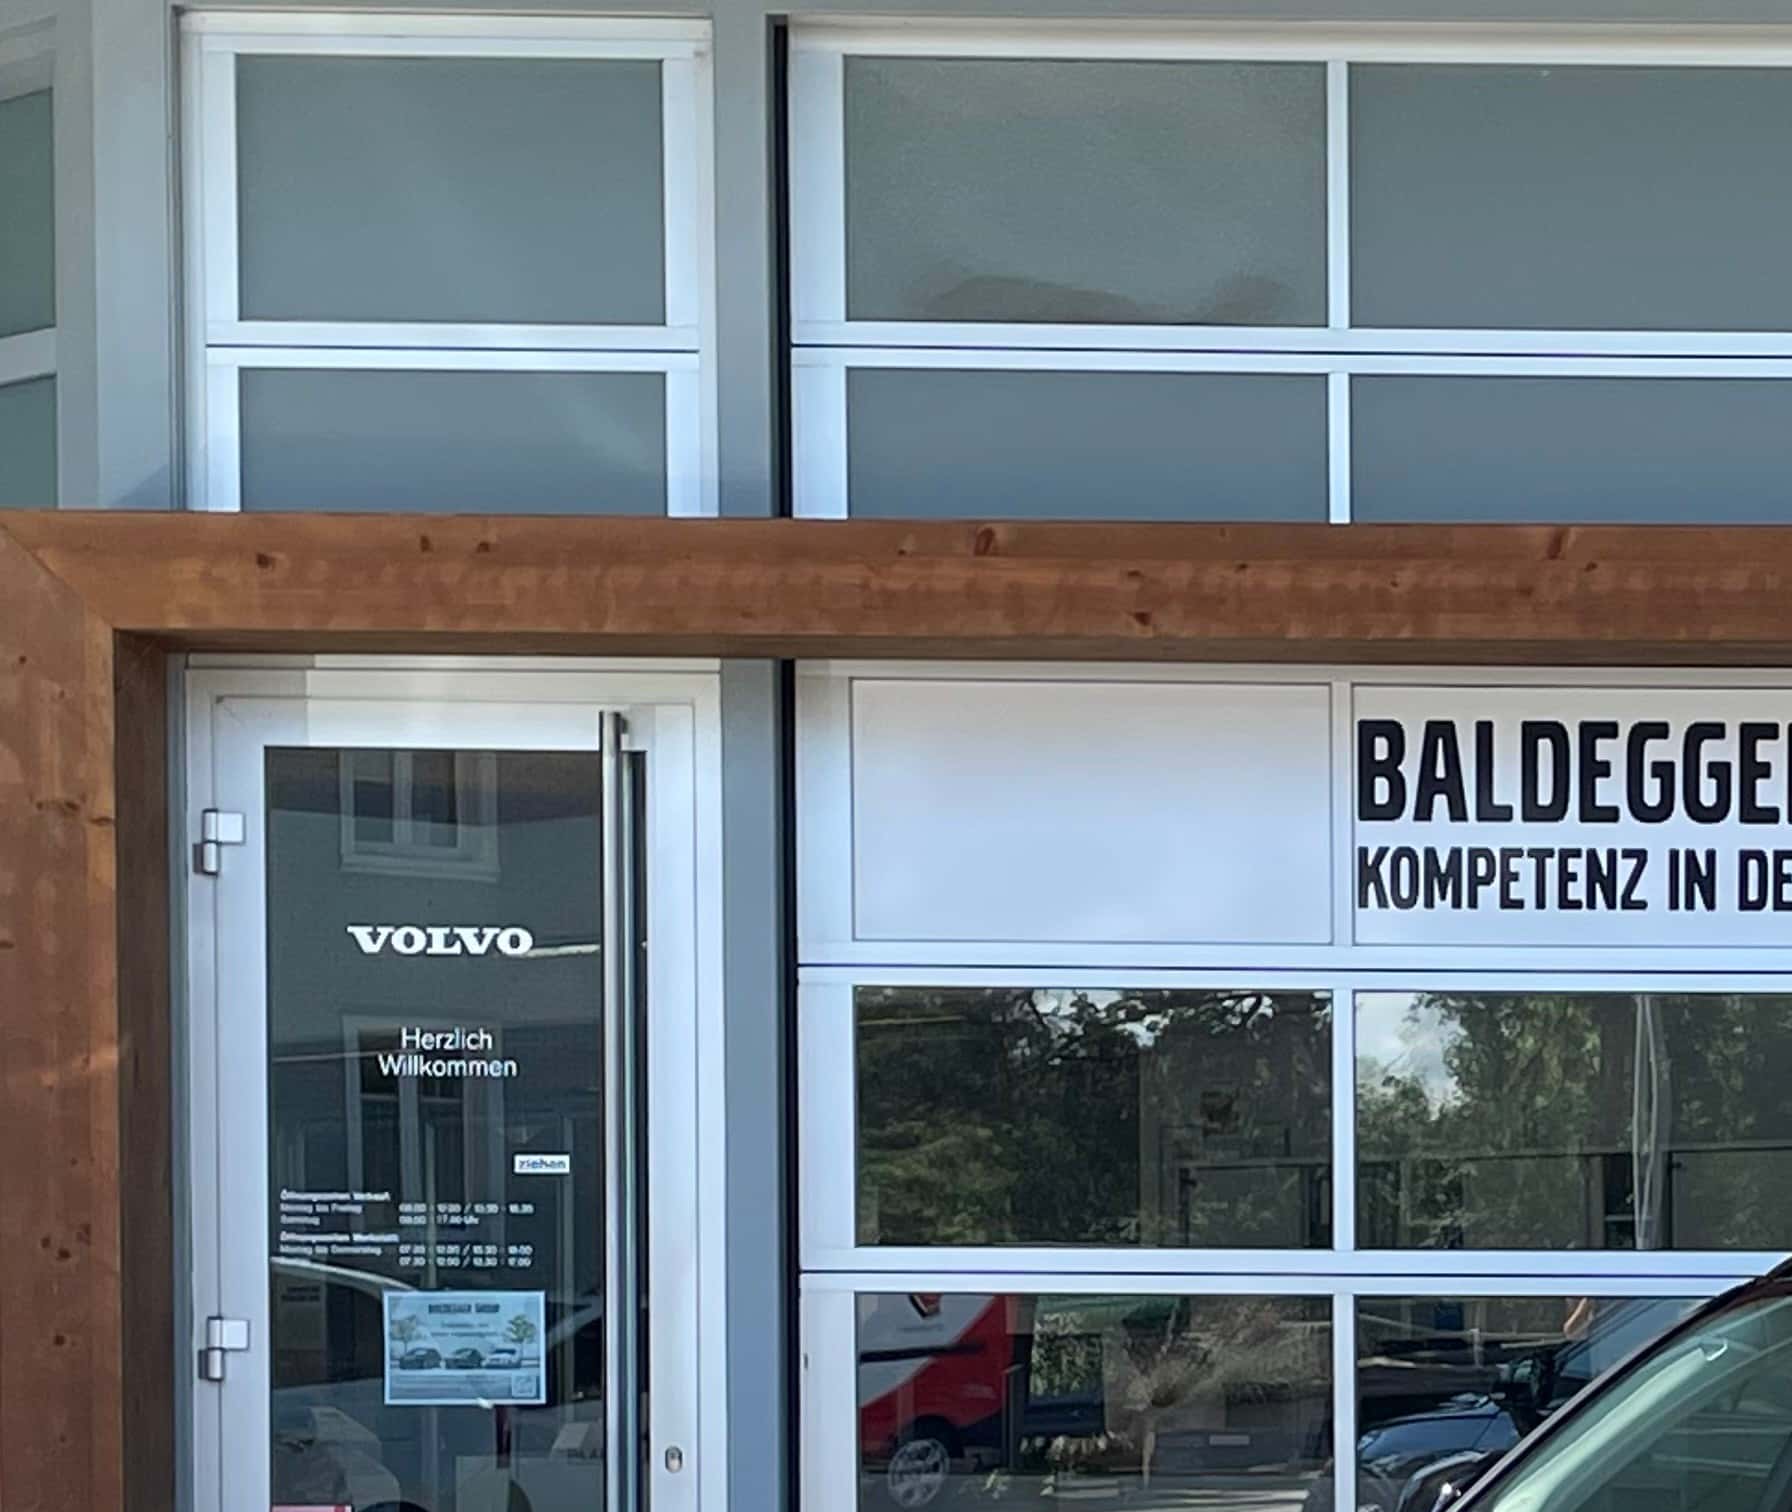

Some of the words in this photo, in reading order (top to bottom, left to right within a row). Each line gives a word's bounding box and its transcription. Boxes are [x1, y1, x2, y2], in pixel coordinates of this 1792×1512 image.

[1358, 846, 1648, 911] KOMPETENZ
[1669, 849, 1717, 911] IN
[346, 925, 534, 955] VOLVO
[400, 1026, 493, 1050] Herzlich
[378, 1053, 518, 1077] Willkommen
